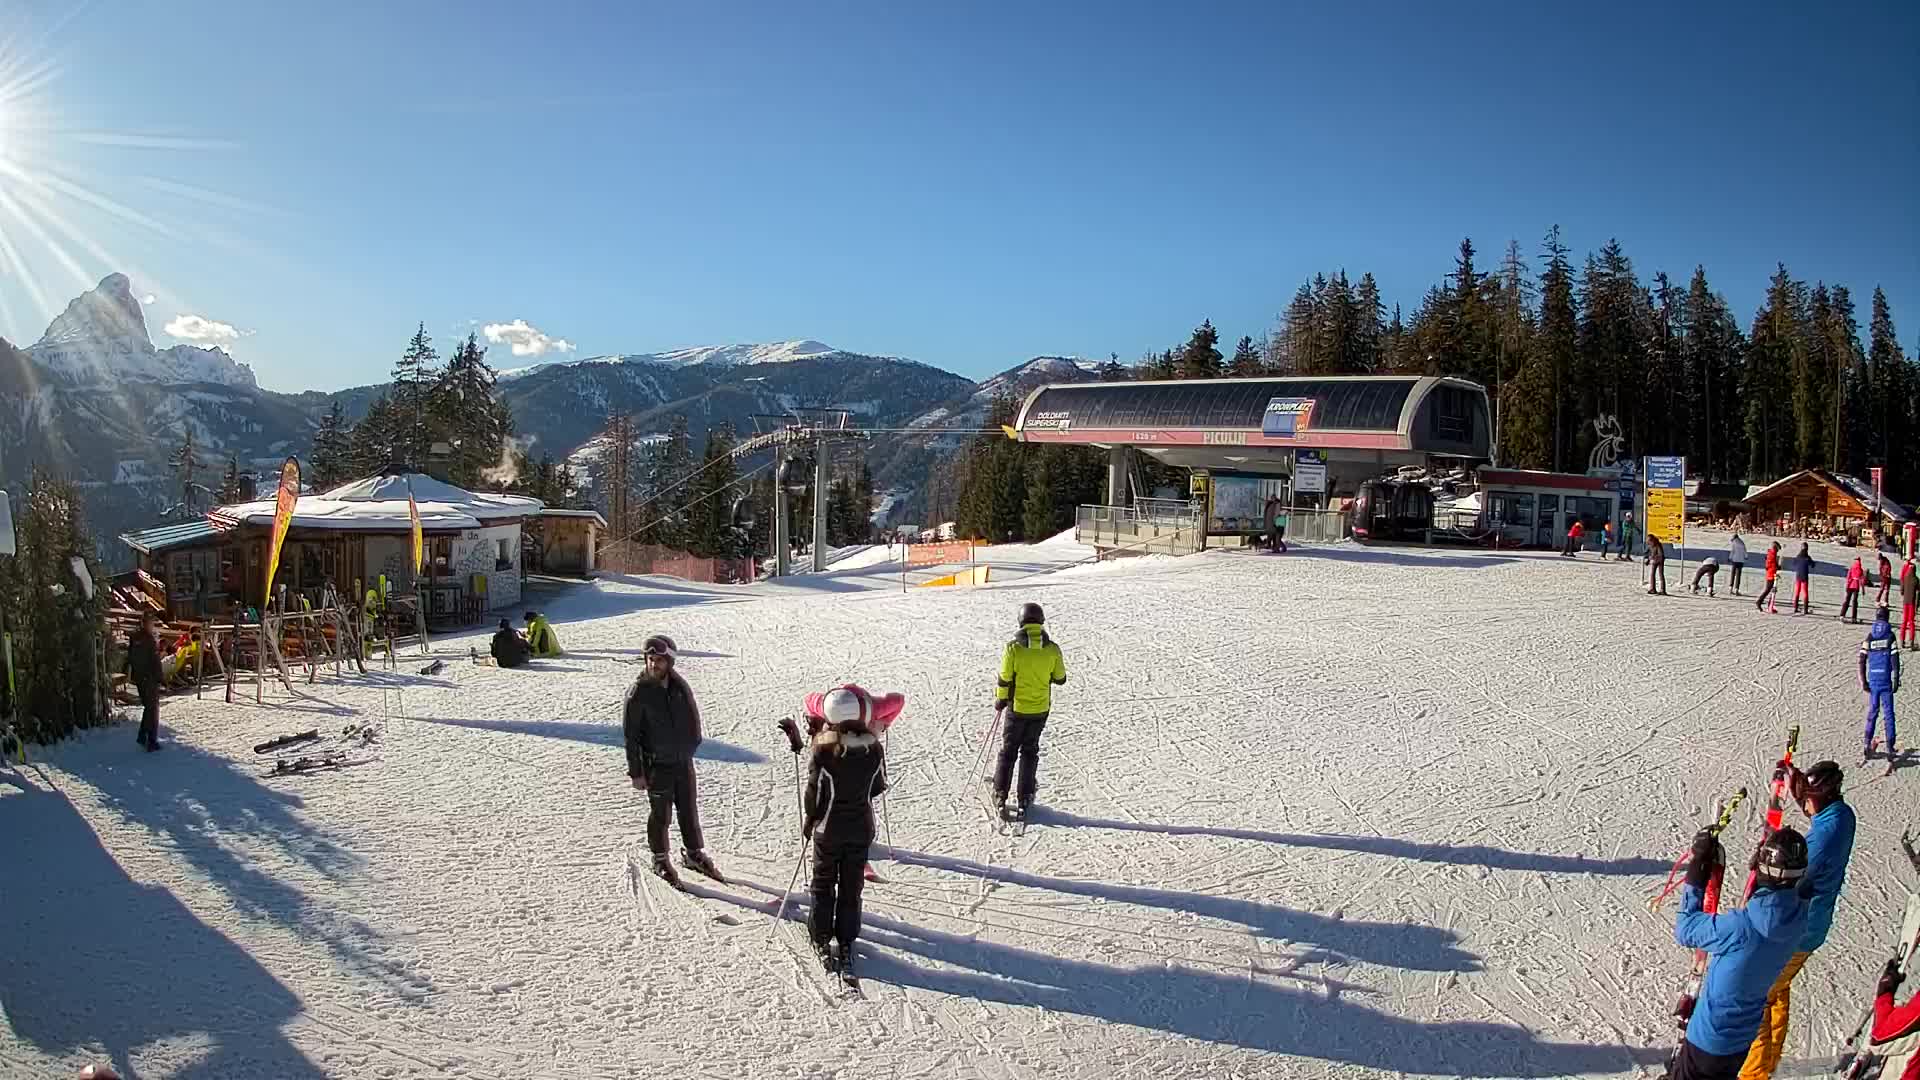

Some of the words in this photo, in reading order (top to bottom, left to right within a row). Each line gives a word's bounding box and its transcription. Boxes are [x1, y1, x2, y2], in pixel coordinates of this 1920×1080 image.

[1268, 402, 1312, 411] KRONPLATZ
[1037, 411, 1070, 419] DOLOMITI
[1203, 432, 1247, 445] PICULIN
